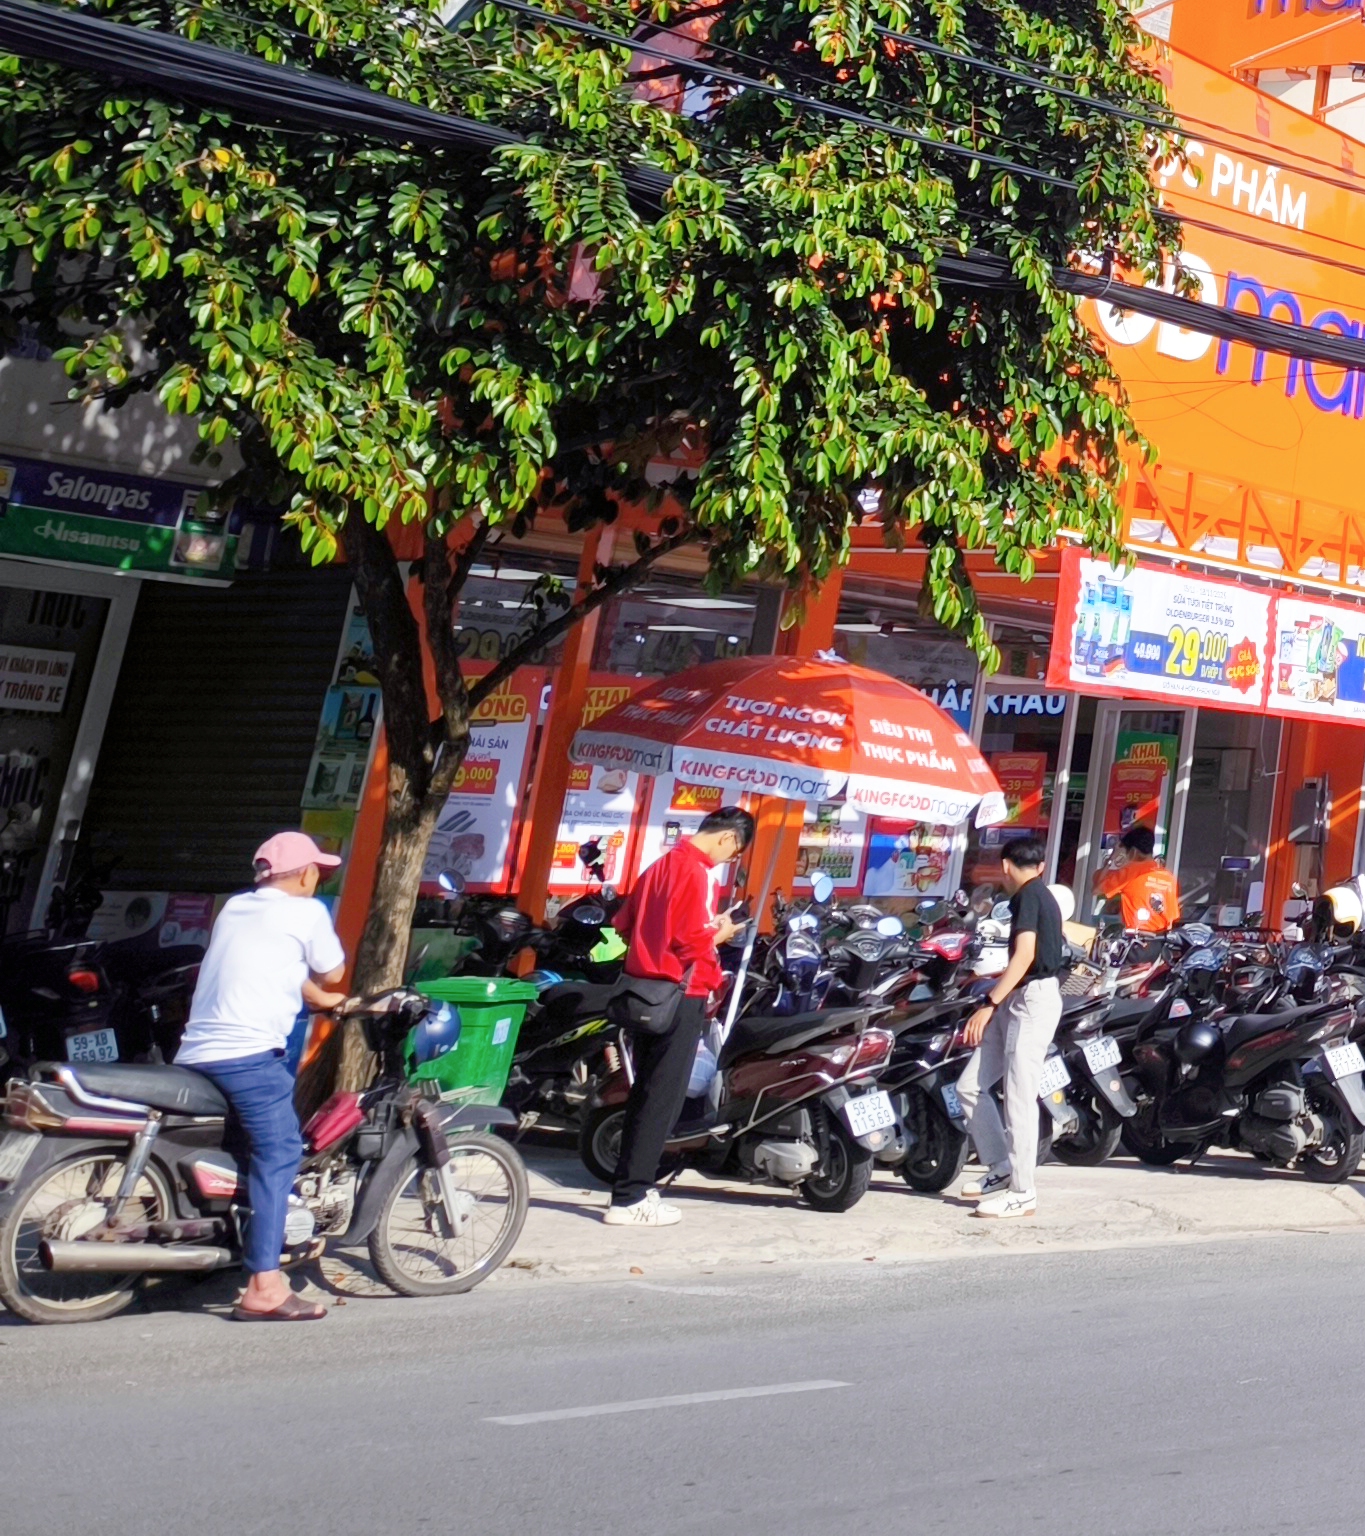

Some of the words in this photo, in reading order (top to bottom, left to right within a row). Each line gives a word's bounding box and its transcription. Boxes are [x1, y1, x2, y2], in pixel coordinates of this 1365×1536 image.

[1211, 152, 1307, 230] PHẨM
[43, 471, 152, 511] Salonpas
[34, 519, 141, 552] Hisamitsu
[1165, 624, 1229, 677] 29.000
[46, 685, 63, 703] XE
[725, 695, 777, 716] TƯƠI
[778, 706, 847, 727] NGON
[705, 718, 764, 740] CHẤT
[764, 726, 843, 752] LƯỢNG
[869, 718, 904, 739] SIÊU
[906, 725, 933, 747] THỊ
[861, 742, 905, 765] THỰC
[906, 748, 957, 773] PHẨM
[1131, 743, 1160, 758] KHAI
[676, 784, 719, 806] 24.000
